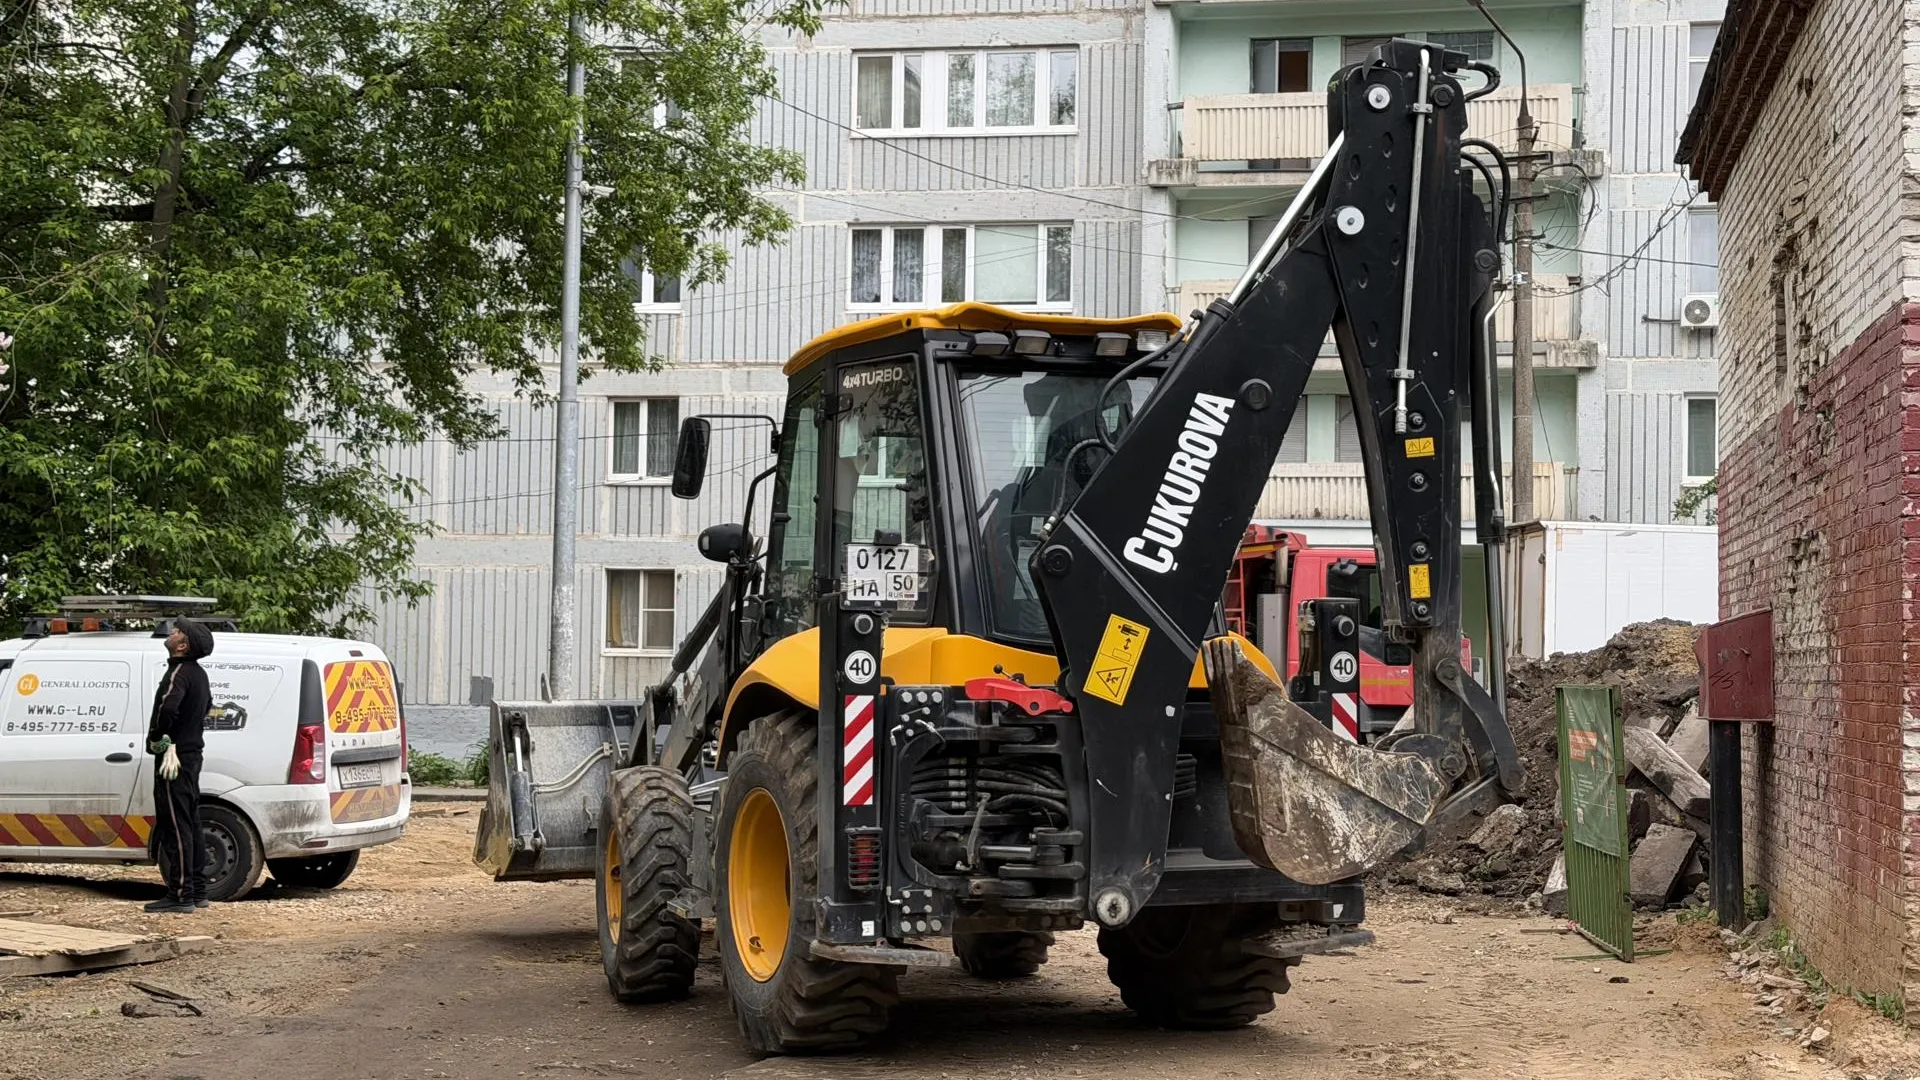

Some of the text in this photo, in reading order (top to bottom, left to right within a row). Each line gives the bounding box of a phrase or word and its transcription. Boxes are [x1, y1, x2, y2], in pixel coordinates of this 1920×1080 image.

[1123, 392, 1236, 575] ÇUKUROVA
[857, 548, 910, 571] 0127
[892, 574, 914, 592] 50
[849, 657, 872, 677] 40
[1333, 657, 1354, 676] 40
[40, 680, 130, 689] GENERAL LOGISTICS
[28, 705, 106, 716] WWW.G--L.RU
[7, 722, 117, 732] 8-495-777-65-62
[331, 738, 366, 748] LADA
